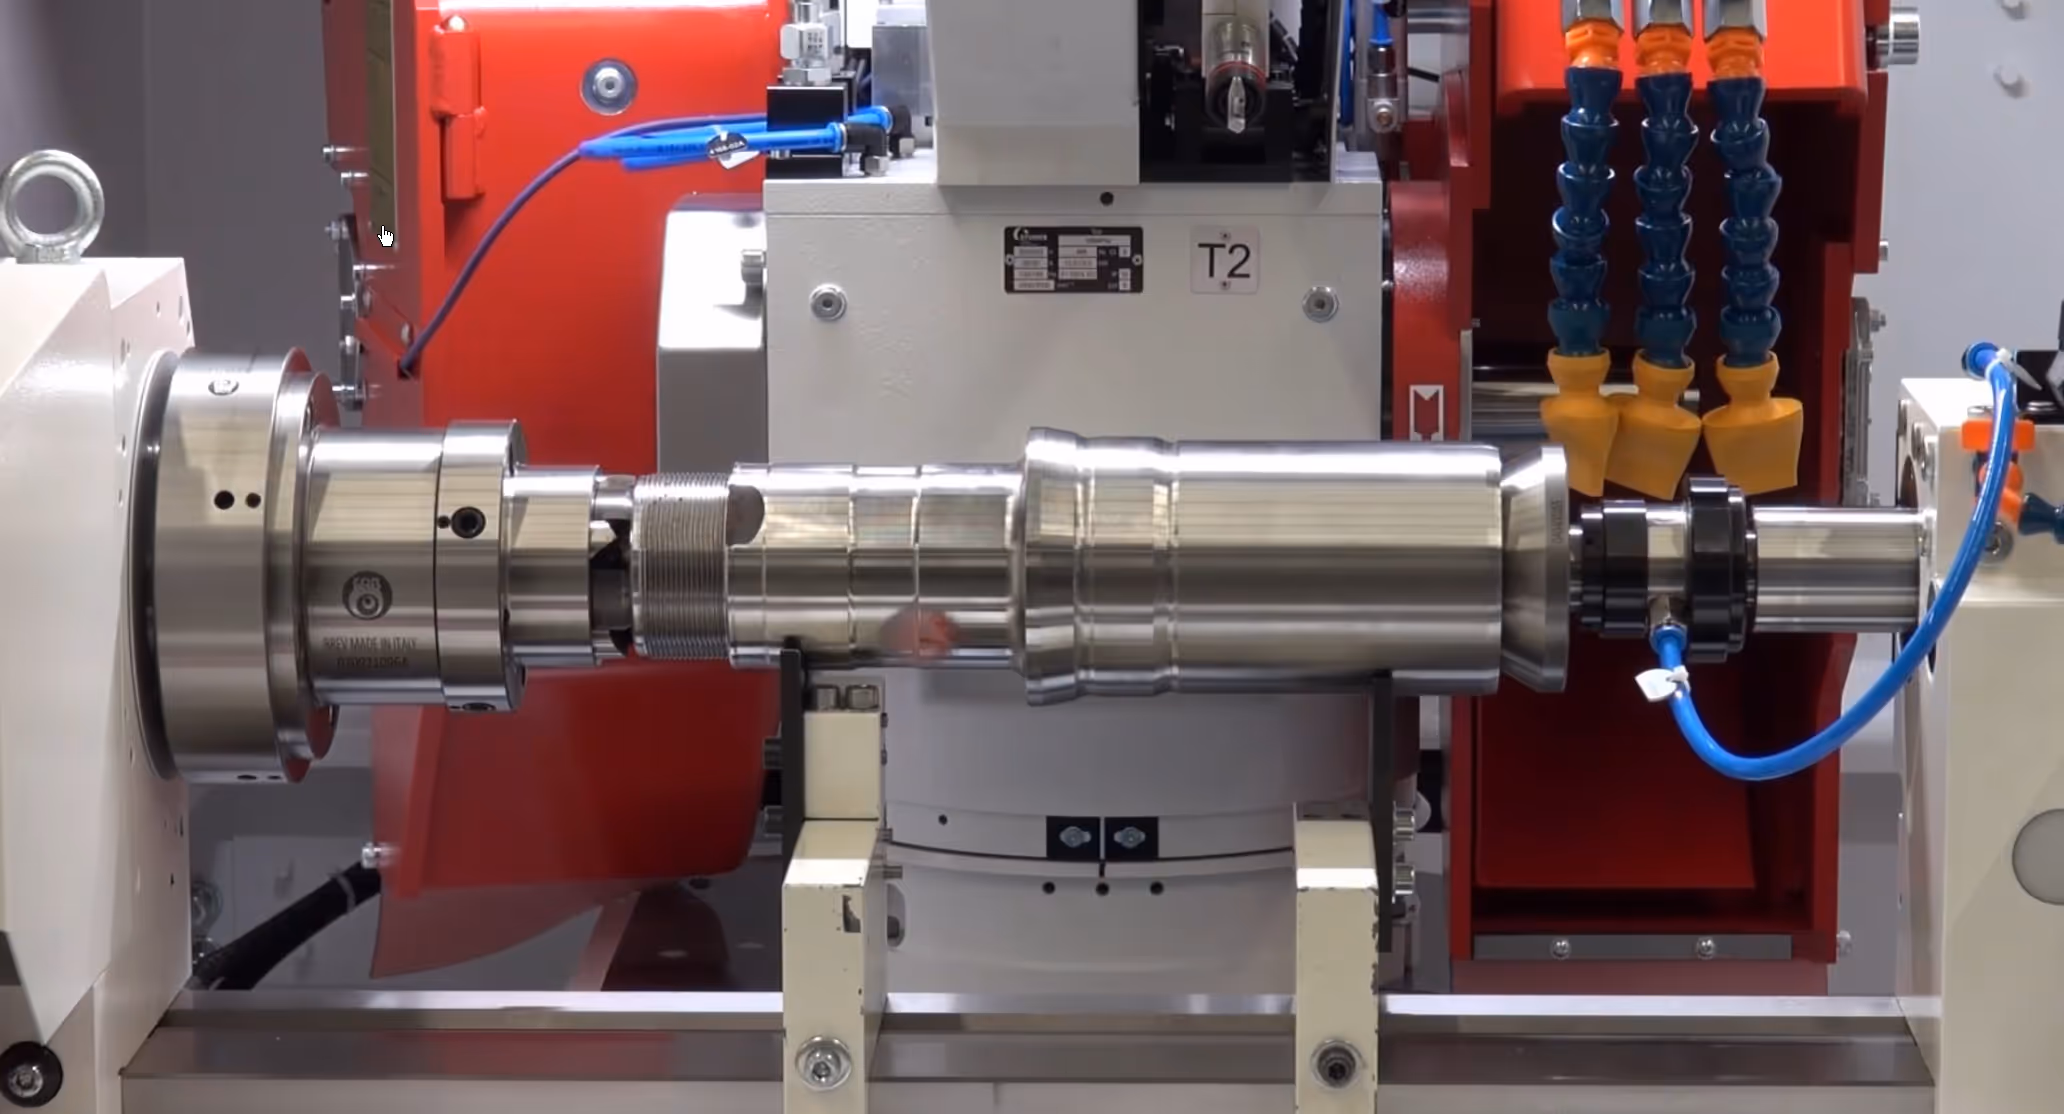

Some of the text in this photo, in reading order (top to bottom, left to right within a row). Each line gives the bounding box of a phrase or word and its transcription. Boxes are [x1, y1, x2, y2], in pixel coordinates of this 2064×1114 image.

[1197, 242, 1251, 279] T2
[350, 636, 378, 651] MADE
[393, 636, 417, 651] ITALY
